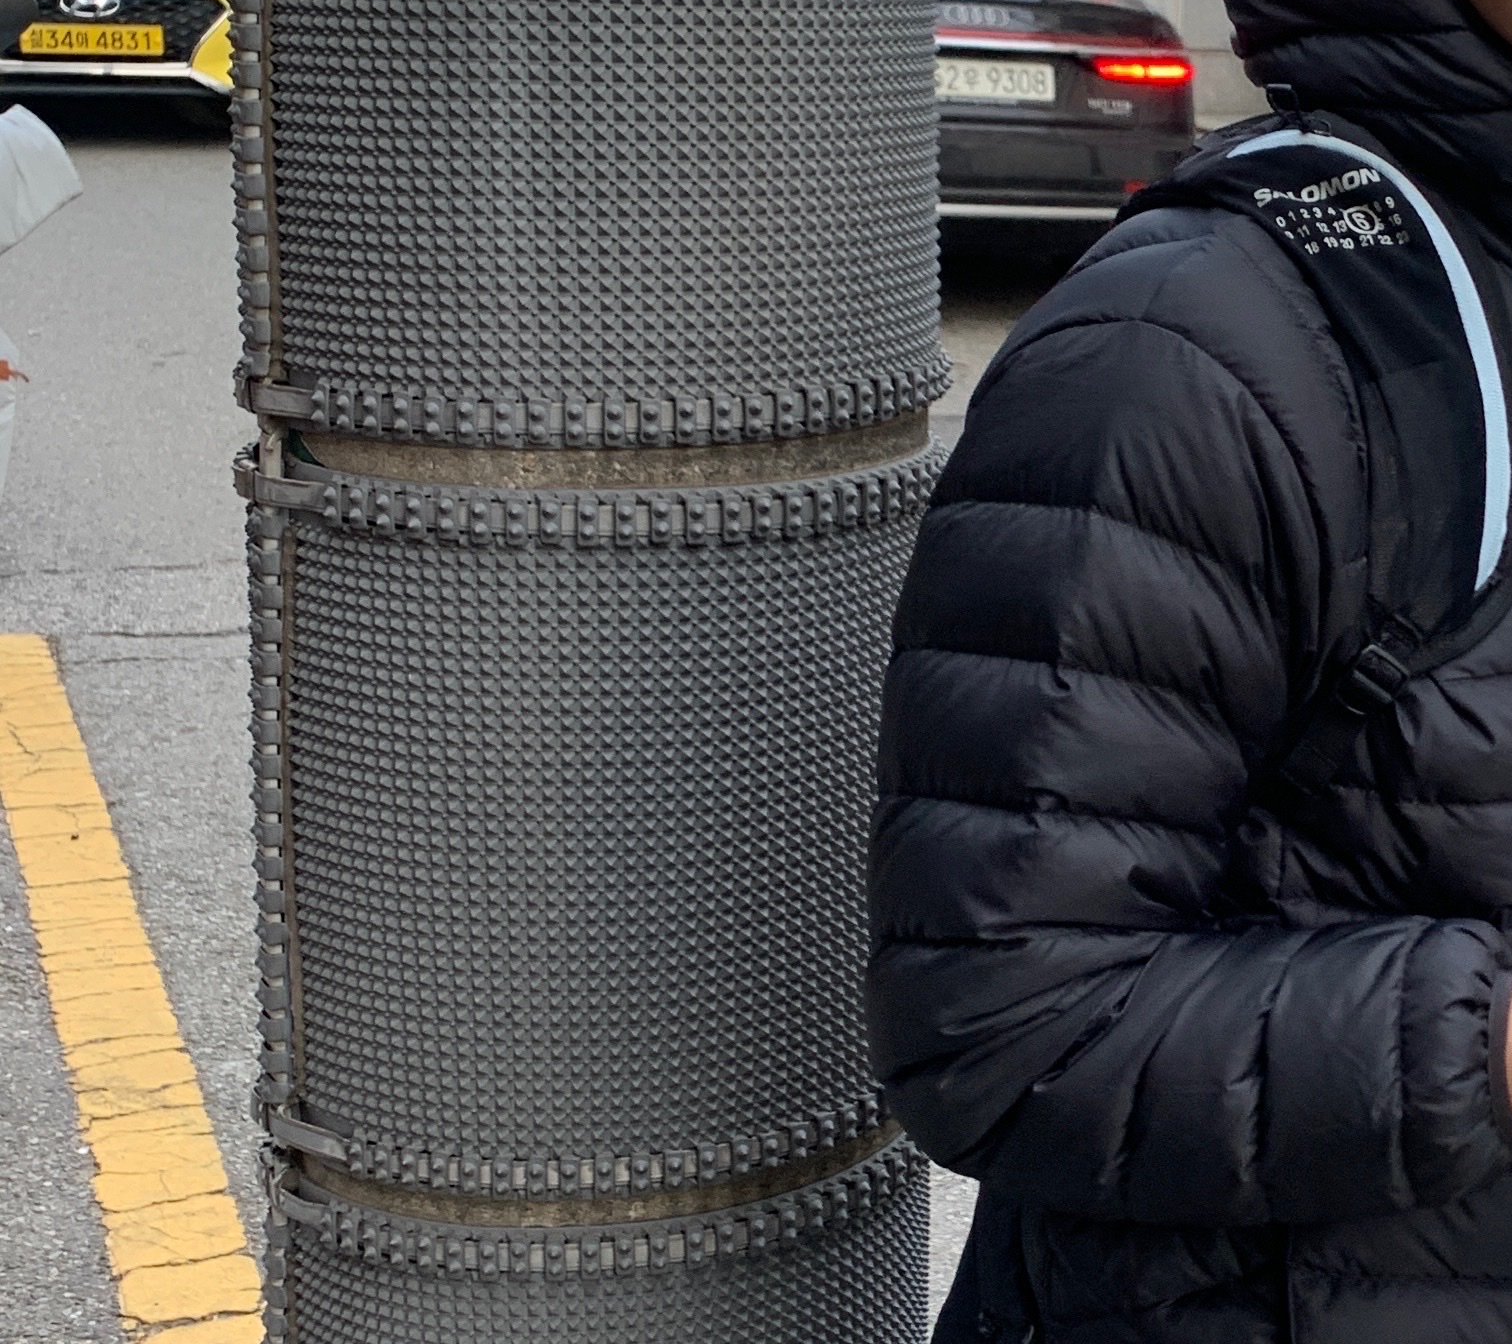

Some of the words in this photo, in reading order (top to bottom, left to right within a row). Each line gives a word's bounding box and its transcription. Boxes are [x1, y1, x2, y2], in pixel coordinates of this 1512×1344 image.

[96, 30, 151, 51] 4831
[986, 65, 1048, 94] 9308
[1253, 168, 1381, 208] SALOMON
[1300, 208, 1311, 219] 2
[1312, 207, 1323, 219] 3
[1351, 212, 1371, 230] 6
[1384, 196, 1395, 209] 9
[1315, 221, 1331, 233] 12
[1332, 219, 1348, 234] 13
[1304, 240, 1321, 255] 18
[1323, 236, 1339, 248] 19
[1359, 234, 1375, 247] 21
